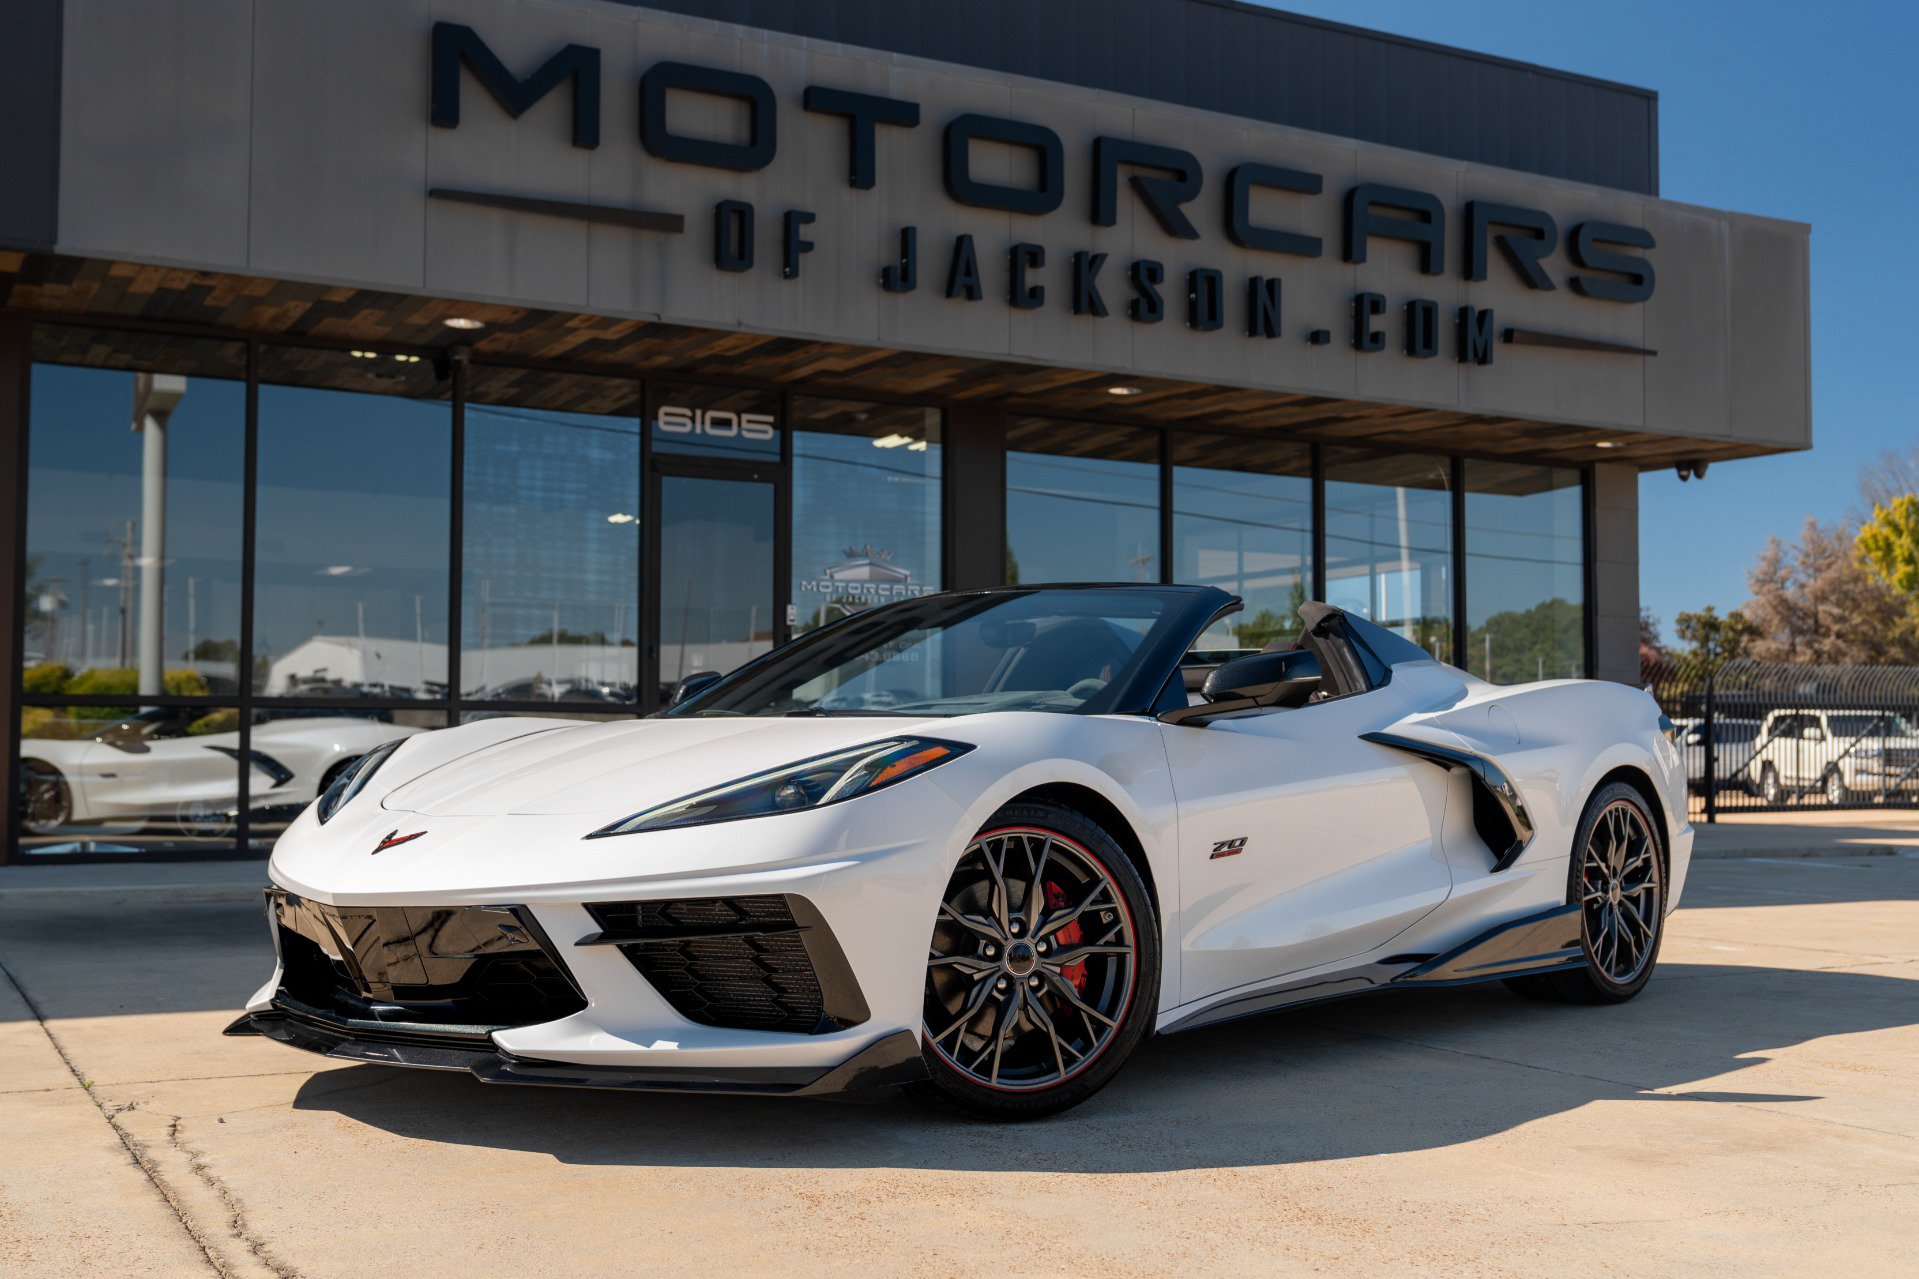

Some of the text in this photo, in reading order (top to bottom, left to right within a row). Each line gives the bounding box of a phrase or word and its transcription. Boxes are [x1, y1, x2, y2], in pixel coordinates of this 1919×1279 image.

[430, 20, 1656, 303] MOTORCARS
[713, 199, 816, 280] OF
[658, 405, 775, 440] 6105
[801, 580, 935, 597] MOTORCARS
[1212, 836, 1249, 853] 70
